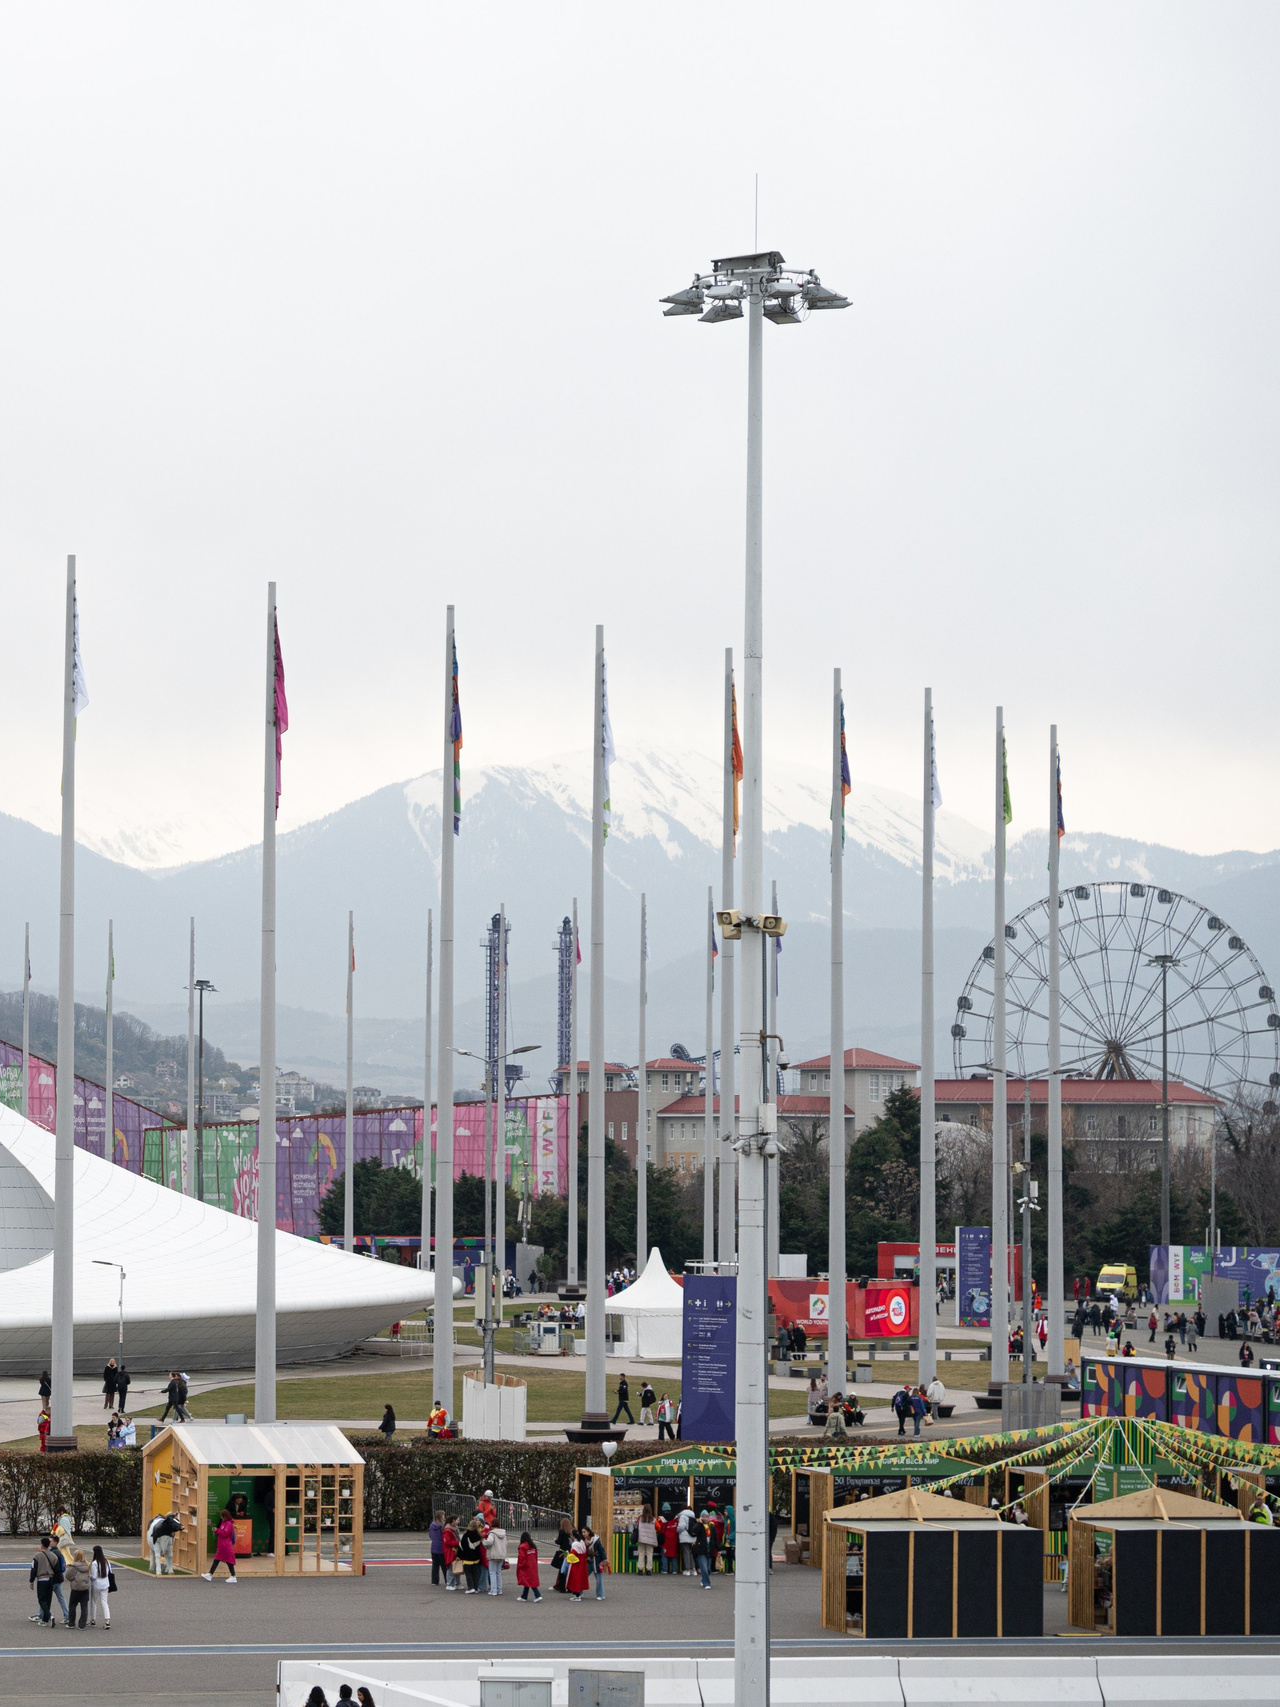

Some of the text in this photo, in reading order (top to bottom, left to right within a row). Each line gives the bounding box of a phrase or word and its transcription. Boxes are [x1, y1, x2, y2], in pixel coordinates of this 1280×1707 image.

[542, 1110, 554, 1158] WYF
[661, 1458, 677, 1466] ПИР
[614, 1476, 624, 1486] 32
[834, 1477, 844, 1486] 30
